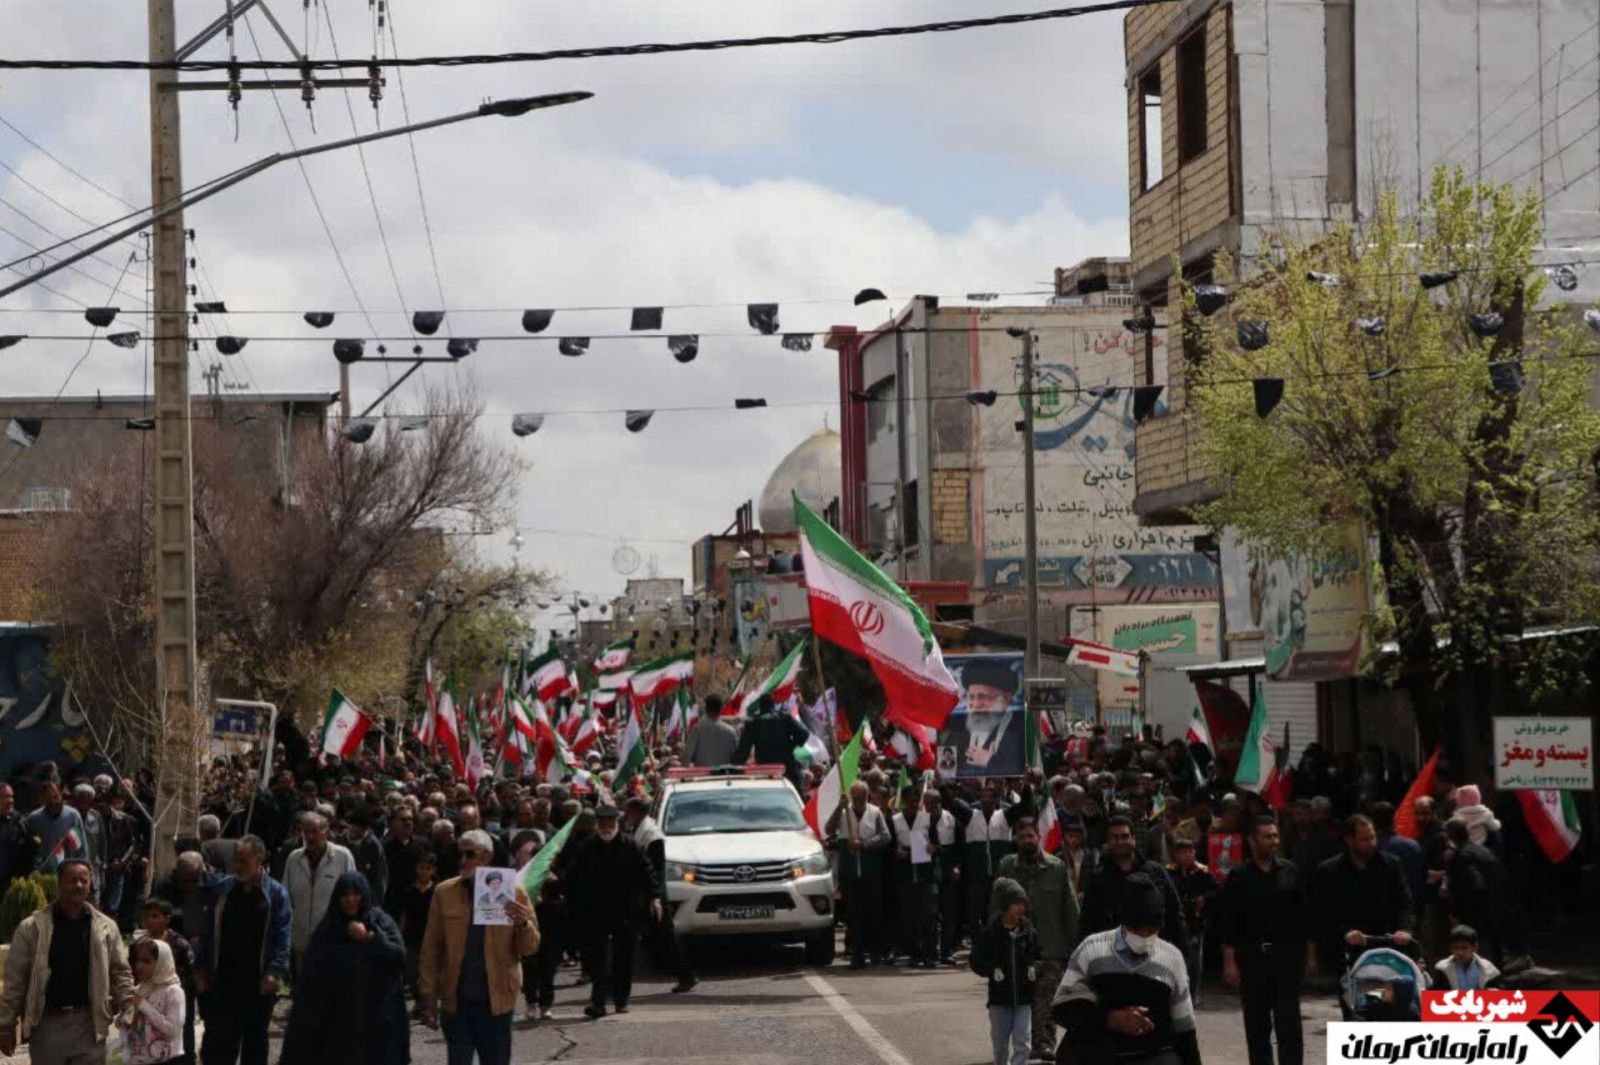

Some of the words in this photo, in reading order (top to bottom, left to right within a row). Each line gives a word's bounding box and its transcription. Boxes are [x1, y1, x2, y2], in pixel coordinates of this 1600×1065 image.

[1083, 465, 1134, 488] جانبی
[1500, 739, 1534, 768] مغز
[1534, 747, 1546, 768] و
[1546, 743, 1589, 769] پسته
